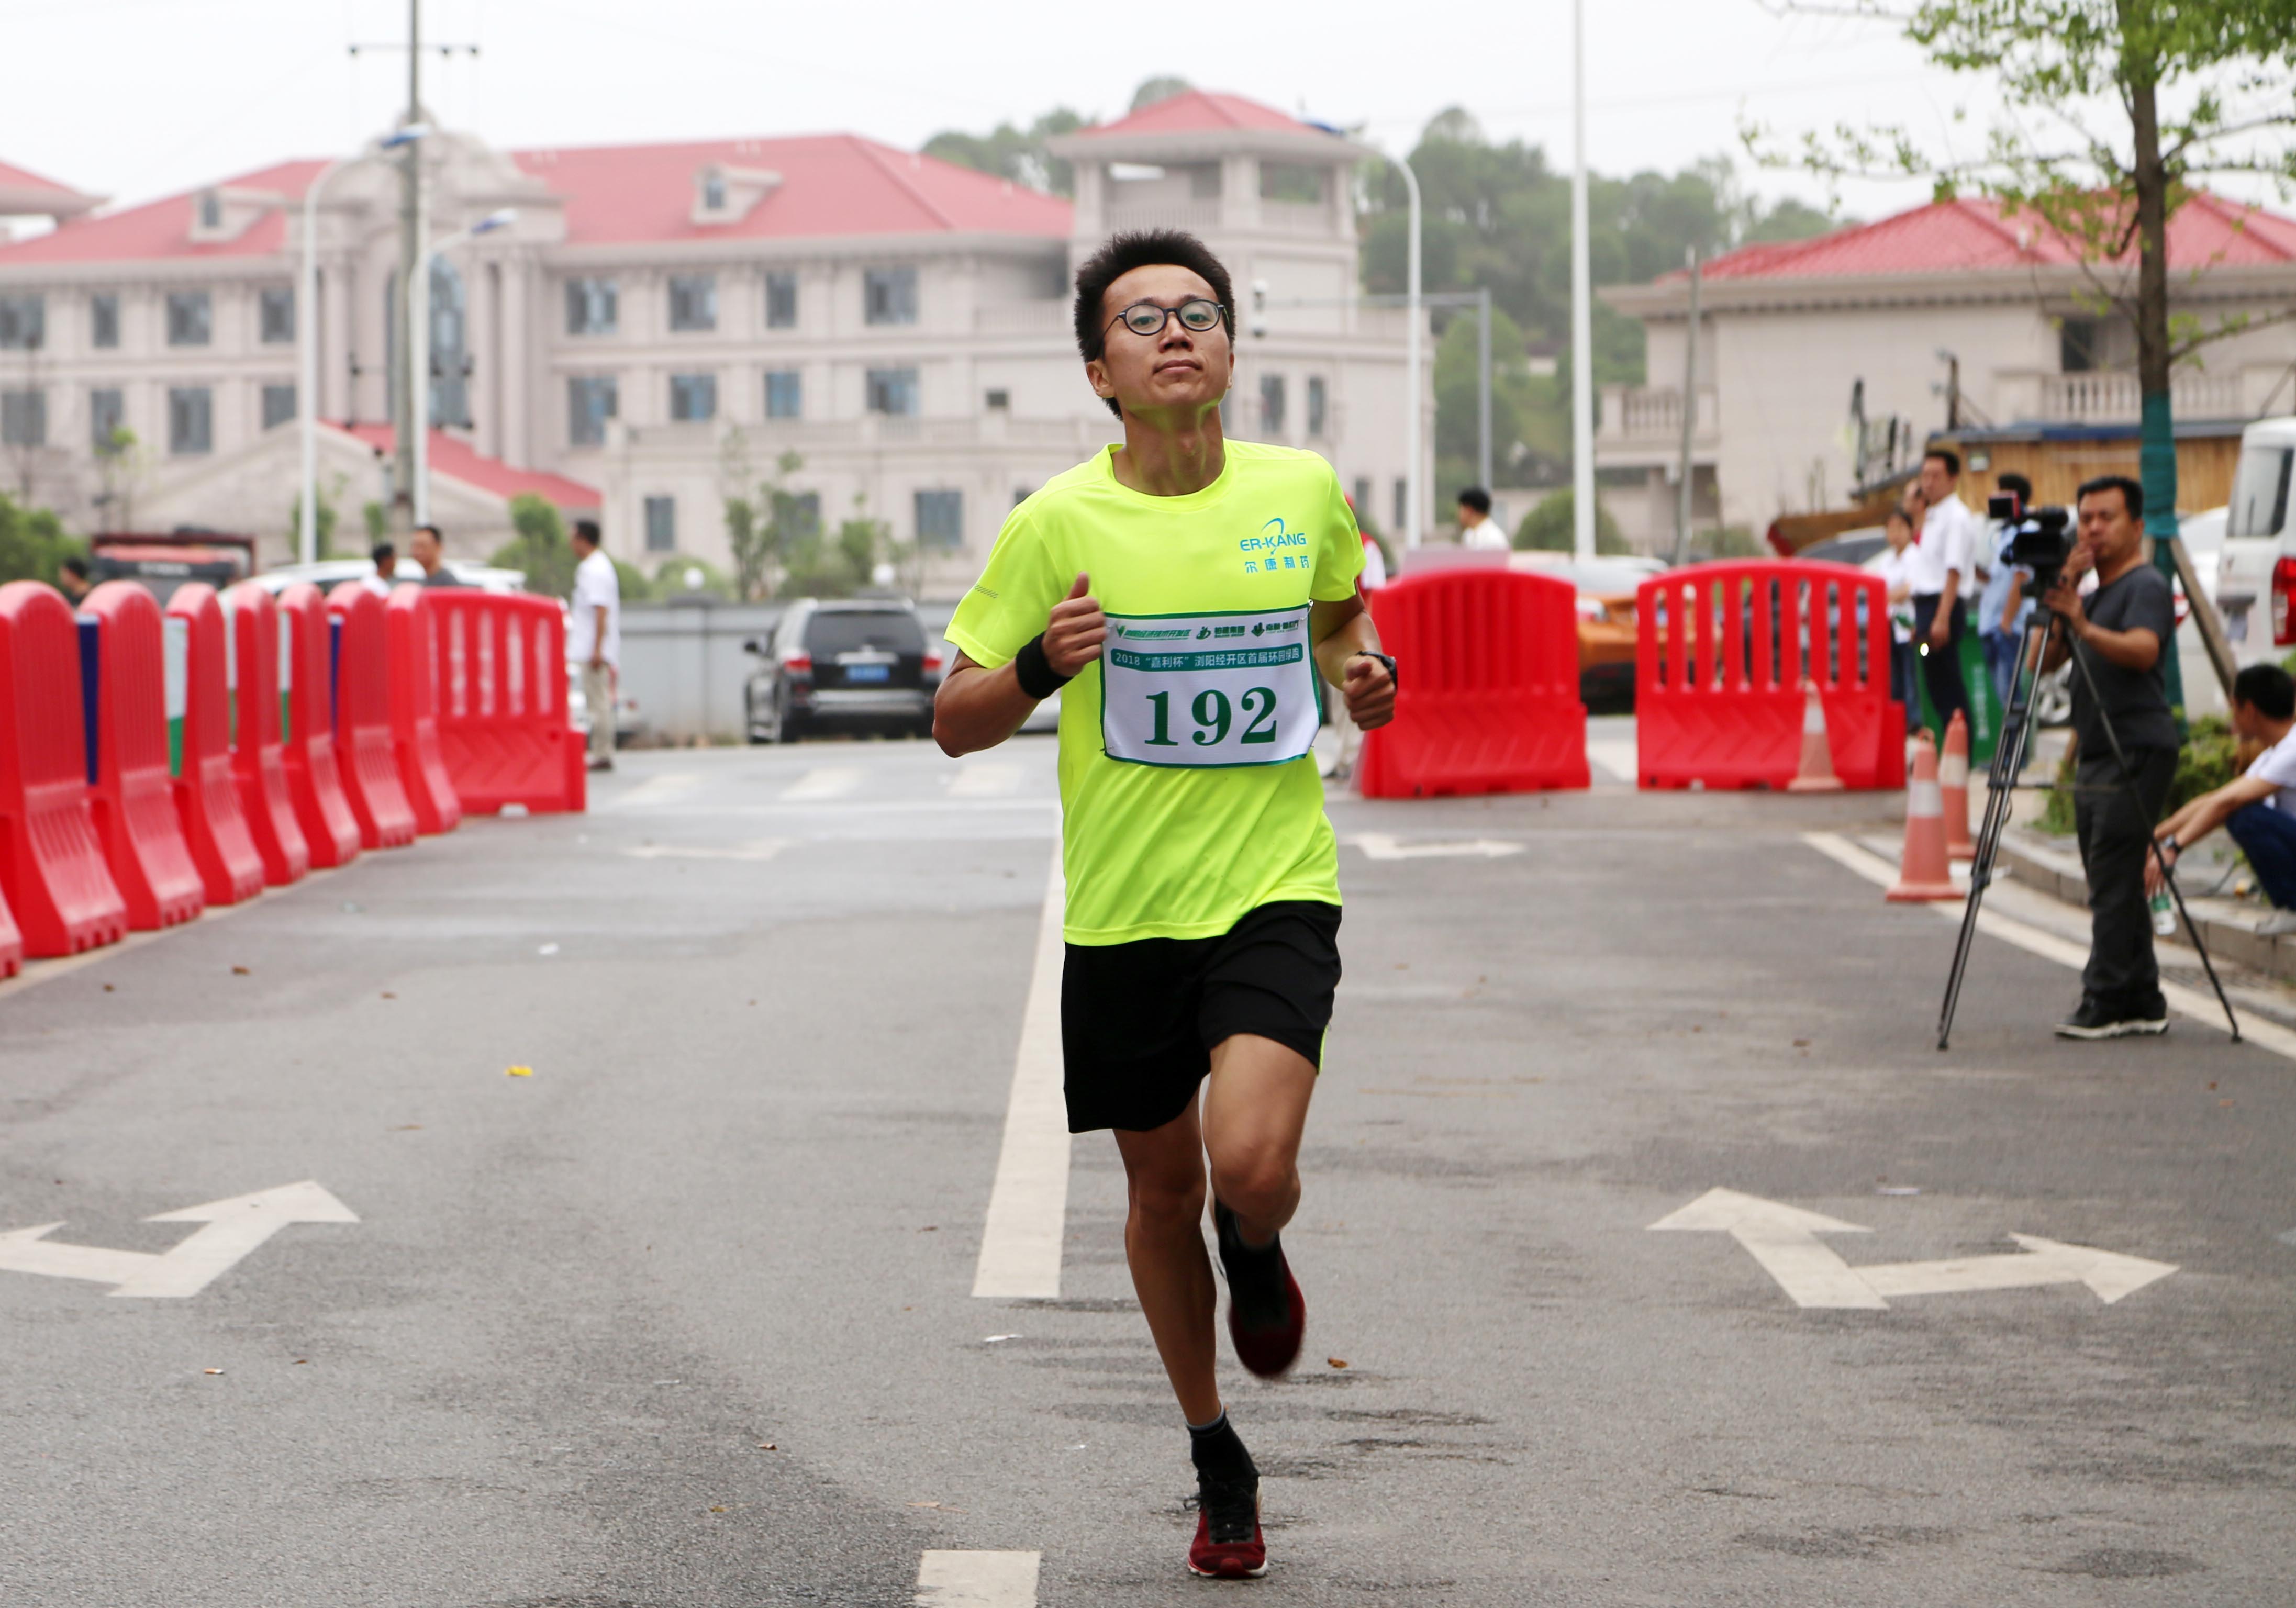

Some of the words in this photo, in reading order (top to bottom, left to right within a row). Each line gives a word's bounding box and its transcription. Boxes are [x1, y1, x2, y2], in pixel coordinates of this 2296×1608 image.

[1240, 533, 1307, 551] ER-KANG
[1245, 555, 1310, 573] 尔康制药
[1116, 653, 1140, 666] 2018
[1144, 687, 1277, 746] 192
